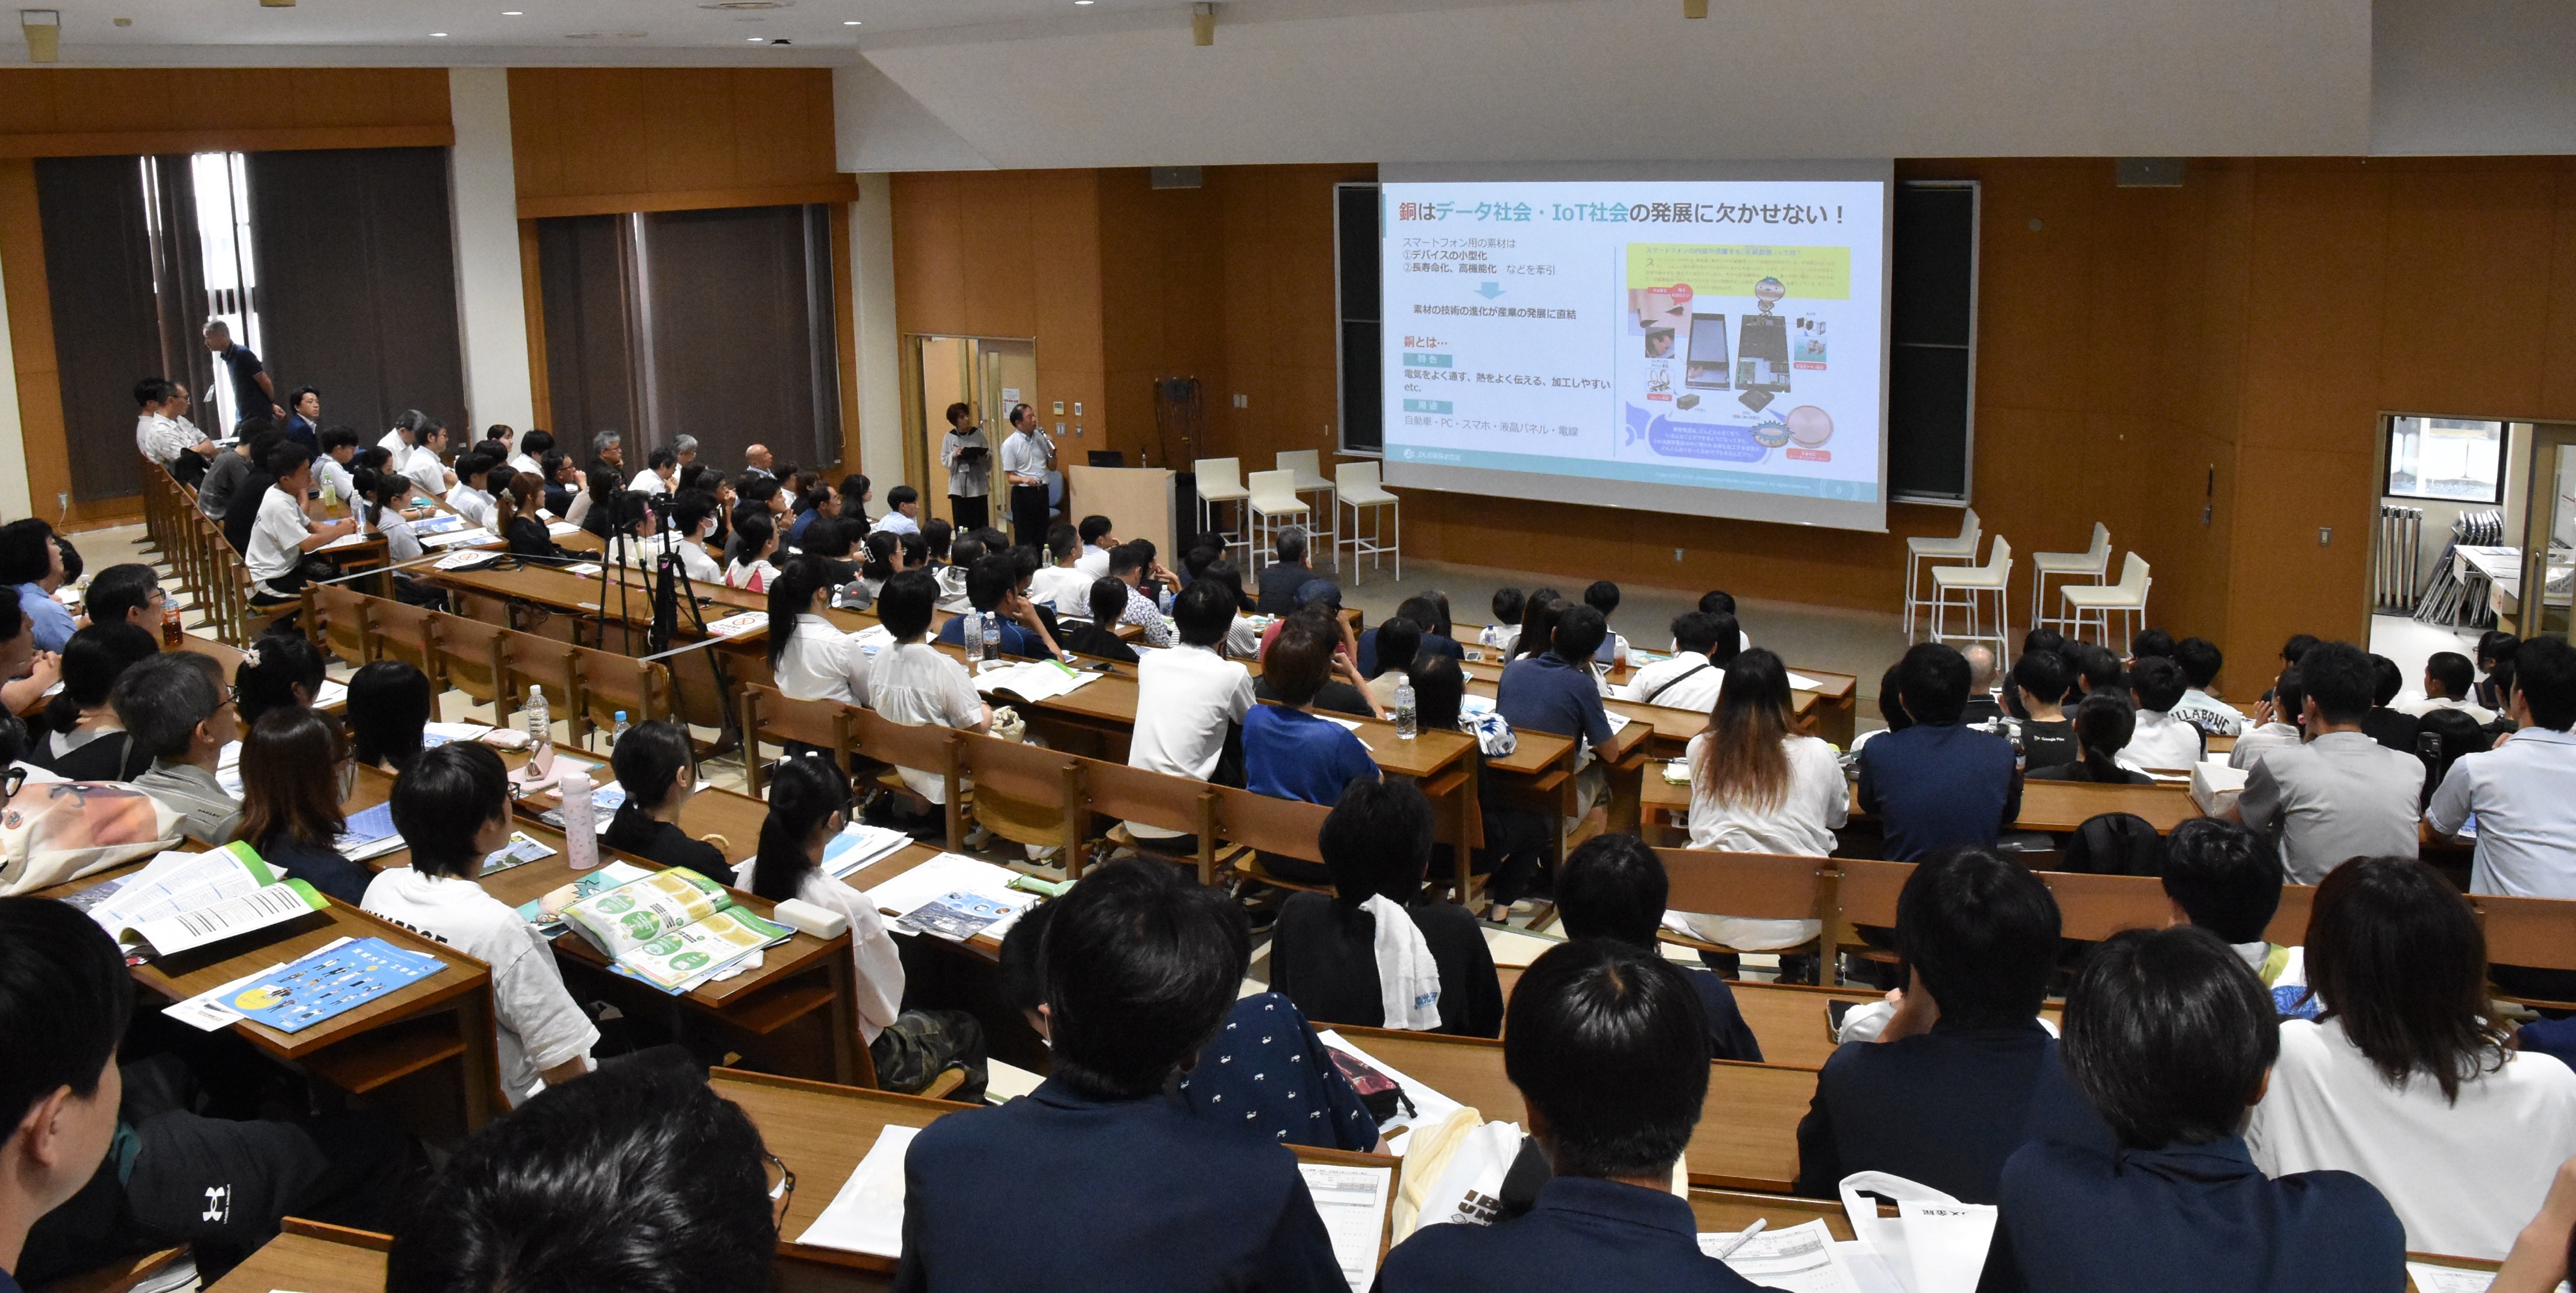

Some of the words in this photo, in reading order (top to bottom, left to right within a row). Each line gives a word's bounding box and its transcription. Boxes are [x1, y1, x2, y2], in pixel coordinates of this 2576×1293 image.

[1399, 201, 1843, 224] 銅はデータ社会・IoT社会の発展に欠かせない！
[1403, 238, 1516, 249] スマートフォン用の素材は
[1403, 250, 1487, 261] ①デバイスの小型化
[1403, 263, 1497, 274] ②長寿命化、高機能化
[1507, 265, 1556, 275] などを牽引
[1413, 304, 1577, 320] 素材の技術の進化が産業の発展に直結
[1404, 369, 1611, 390] 電気をよく通す、熱をよく伝える、加工しやすい
[1404, 383, 1422, 392] etc.
[1405, 415, 1579, 437] 自動車・PC・スマホ・液晶パネル・電線
